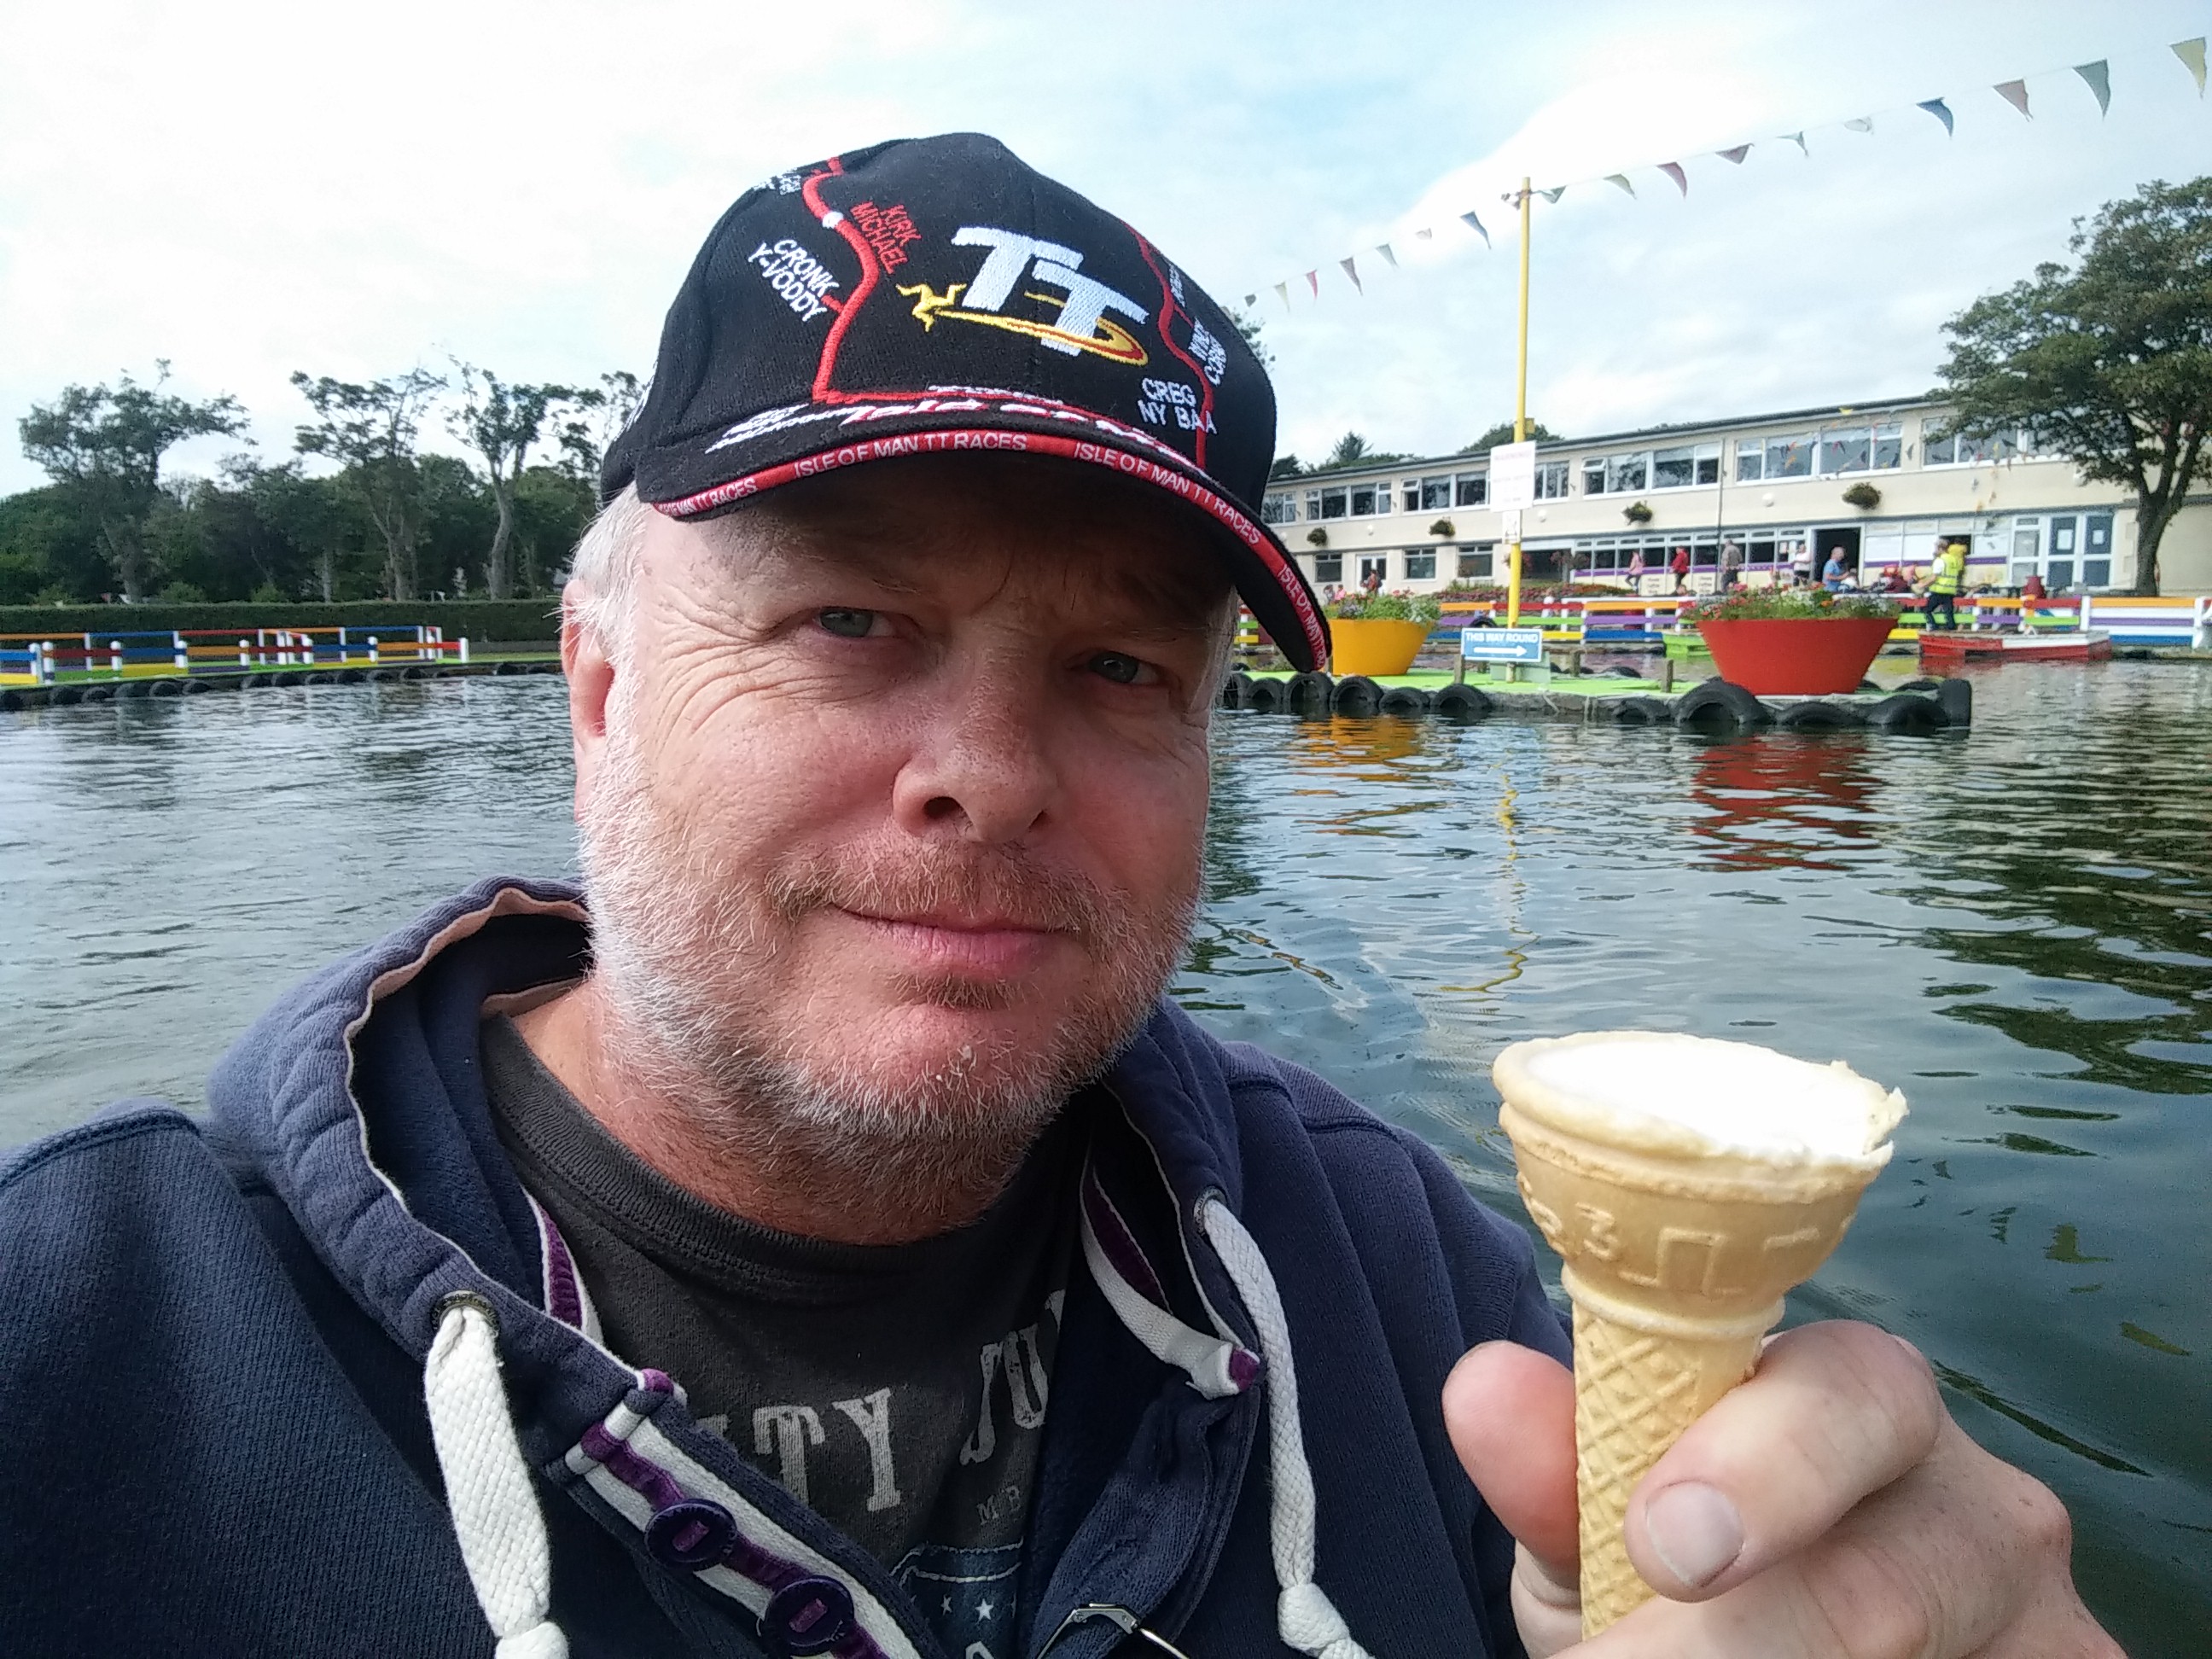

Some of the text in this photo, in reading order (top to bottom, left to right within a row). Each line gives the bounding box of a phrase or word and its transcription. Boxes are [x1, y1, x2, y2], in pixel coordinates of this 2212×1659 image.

[850, 201, 911, 275] MICHAEL
[880, 204, 923, 247] KIRK
[748, 242, 828, 323] Y-VODDY
[774, 239, 840, 298] CRONK
[951, 225, 1150, 357] TT
[1142, 378, 1196, 407] CREG
[1138, 399, 1218, 435] NY BAA
[794, 432, 1028, 479] ISLE OF MAN TT RACES
[709, 477, 759, 506] RACES
[1074, 442, 1262, 545] ISLE OF MAN TT RACES
[1278, 563, 1305, 599] ISLE
[1465, 632, 1539, 644] THIS WAY ROUND
[696, 1387, 901, 1512] TY
